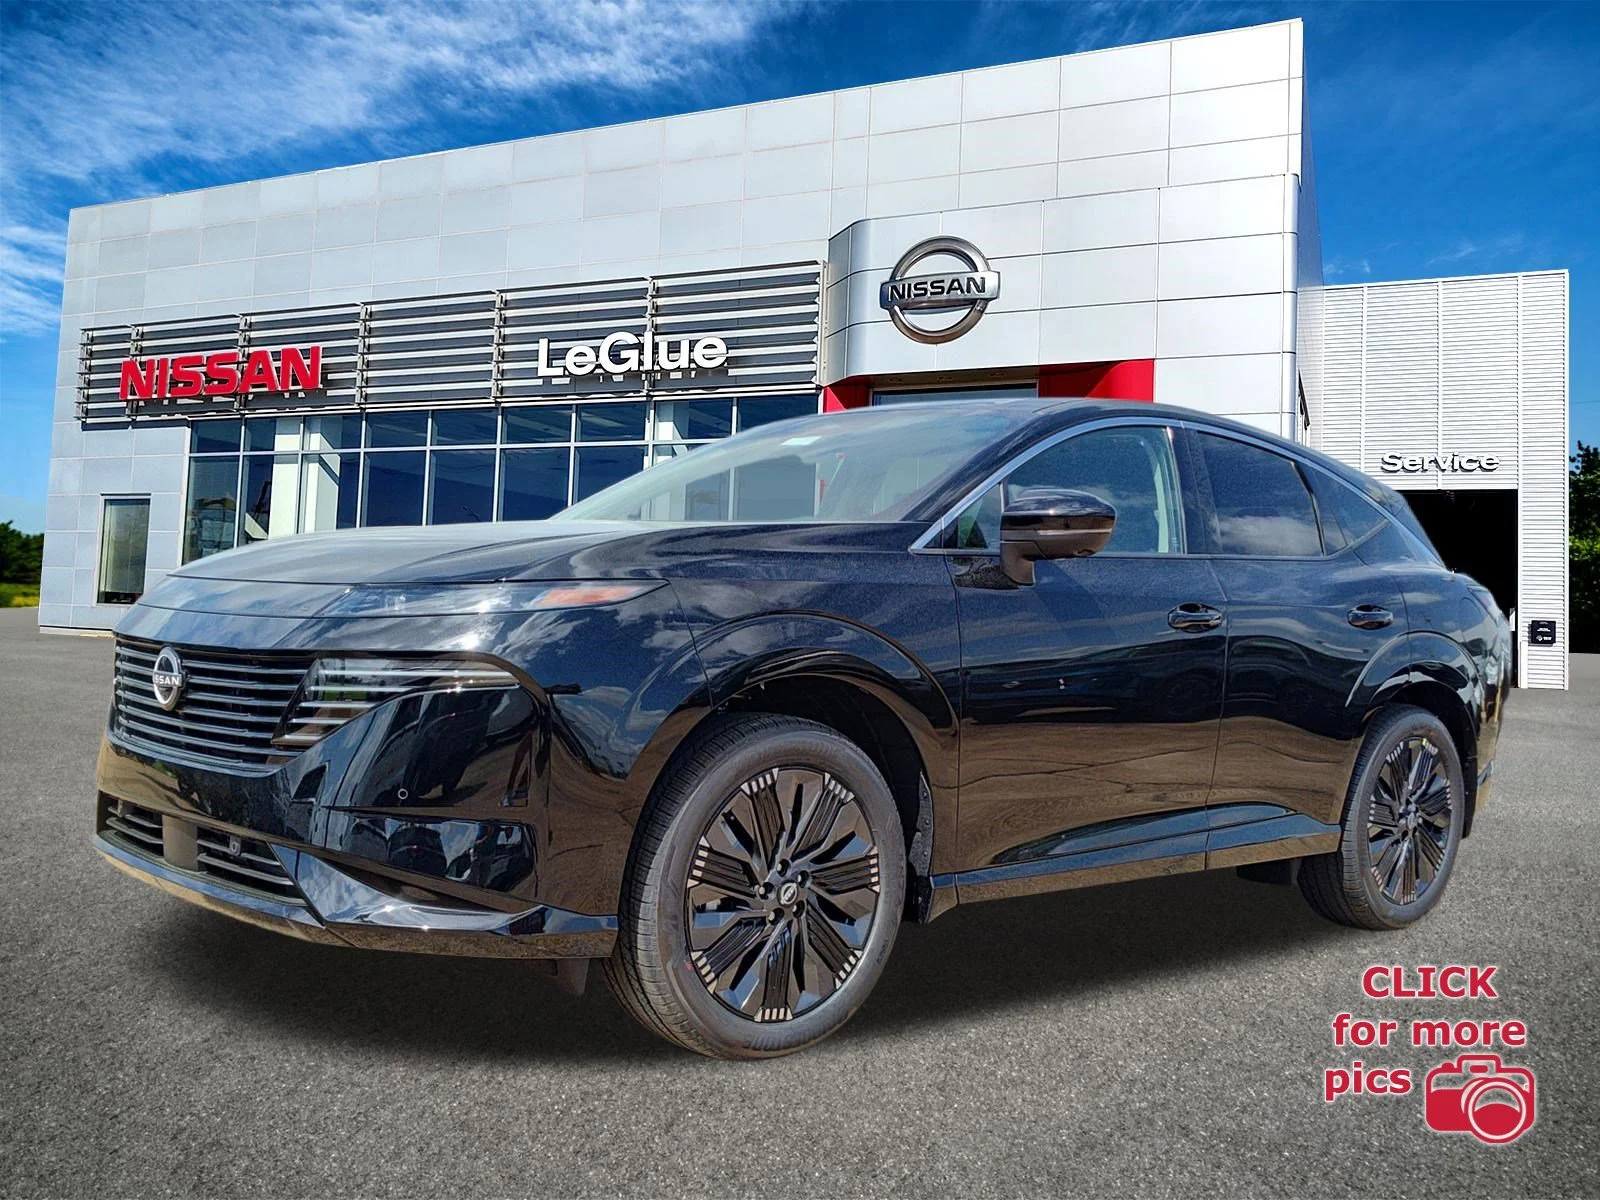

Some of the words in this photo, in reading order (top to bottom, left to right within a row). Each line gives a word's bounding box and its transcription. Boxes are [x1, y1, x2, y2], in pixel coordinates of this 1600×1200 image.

[888, 276, 986, 302] NISSAN
[537, 331, 728, 377] LeGlue
[119, 345, 323, 400] NISSAN
[1381, 451, 1499, 472] Service
